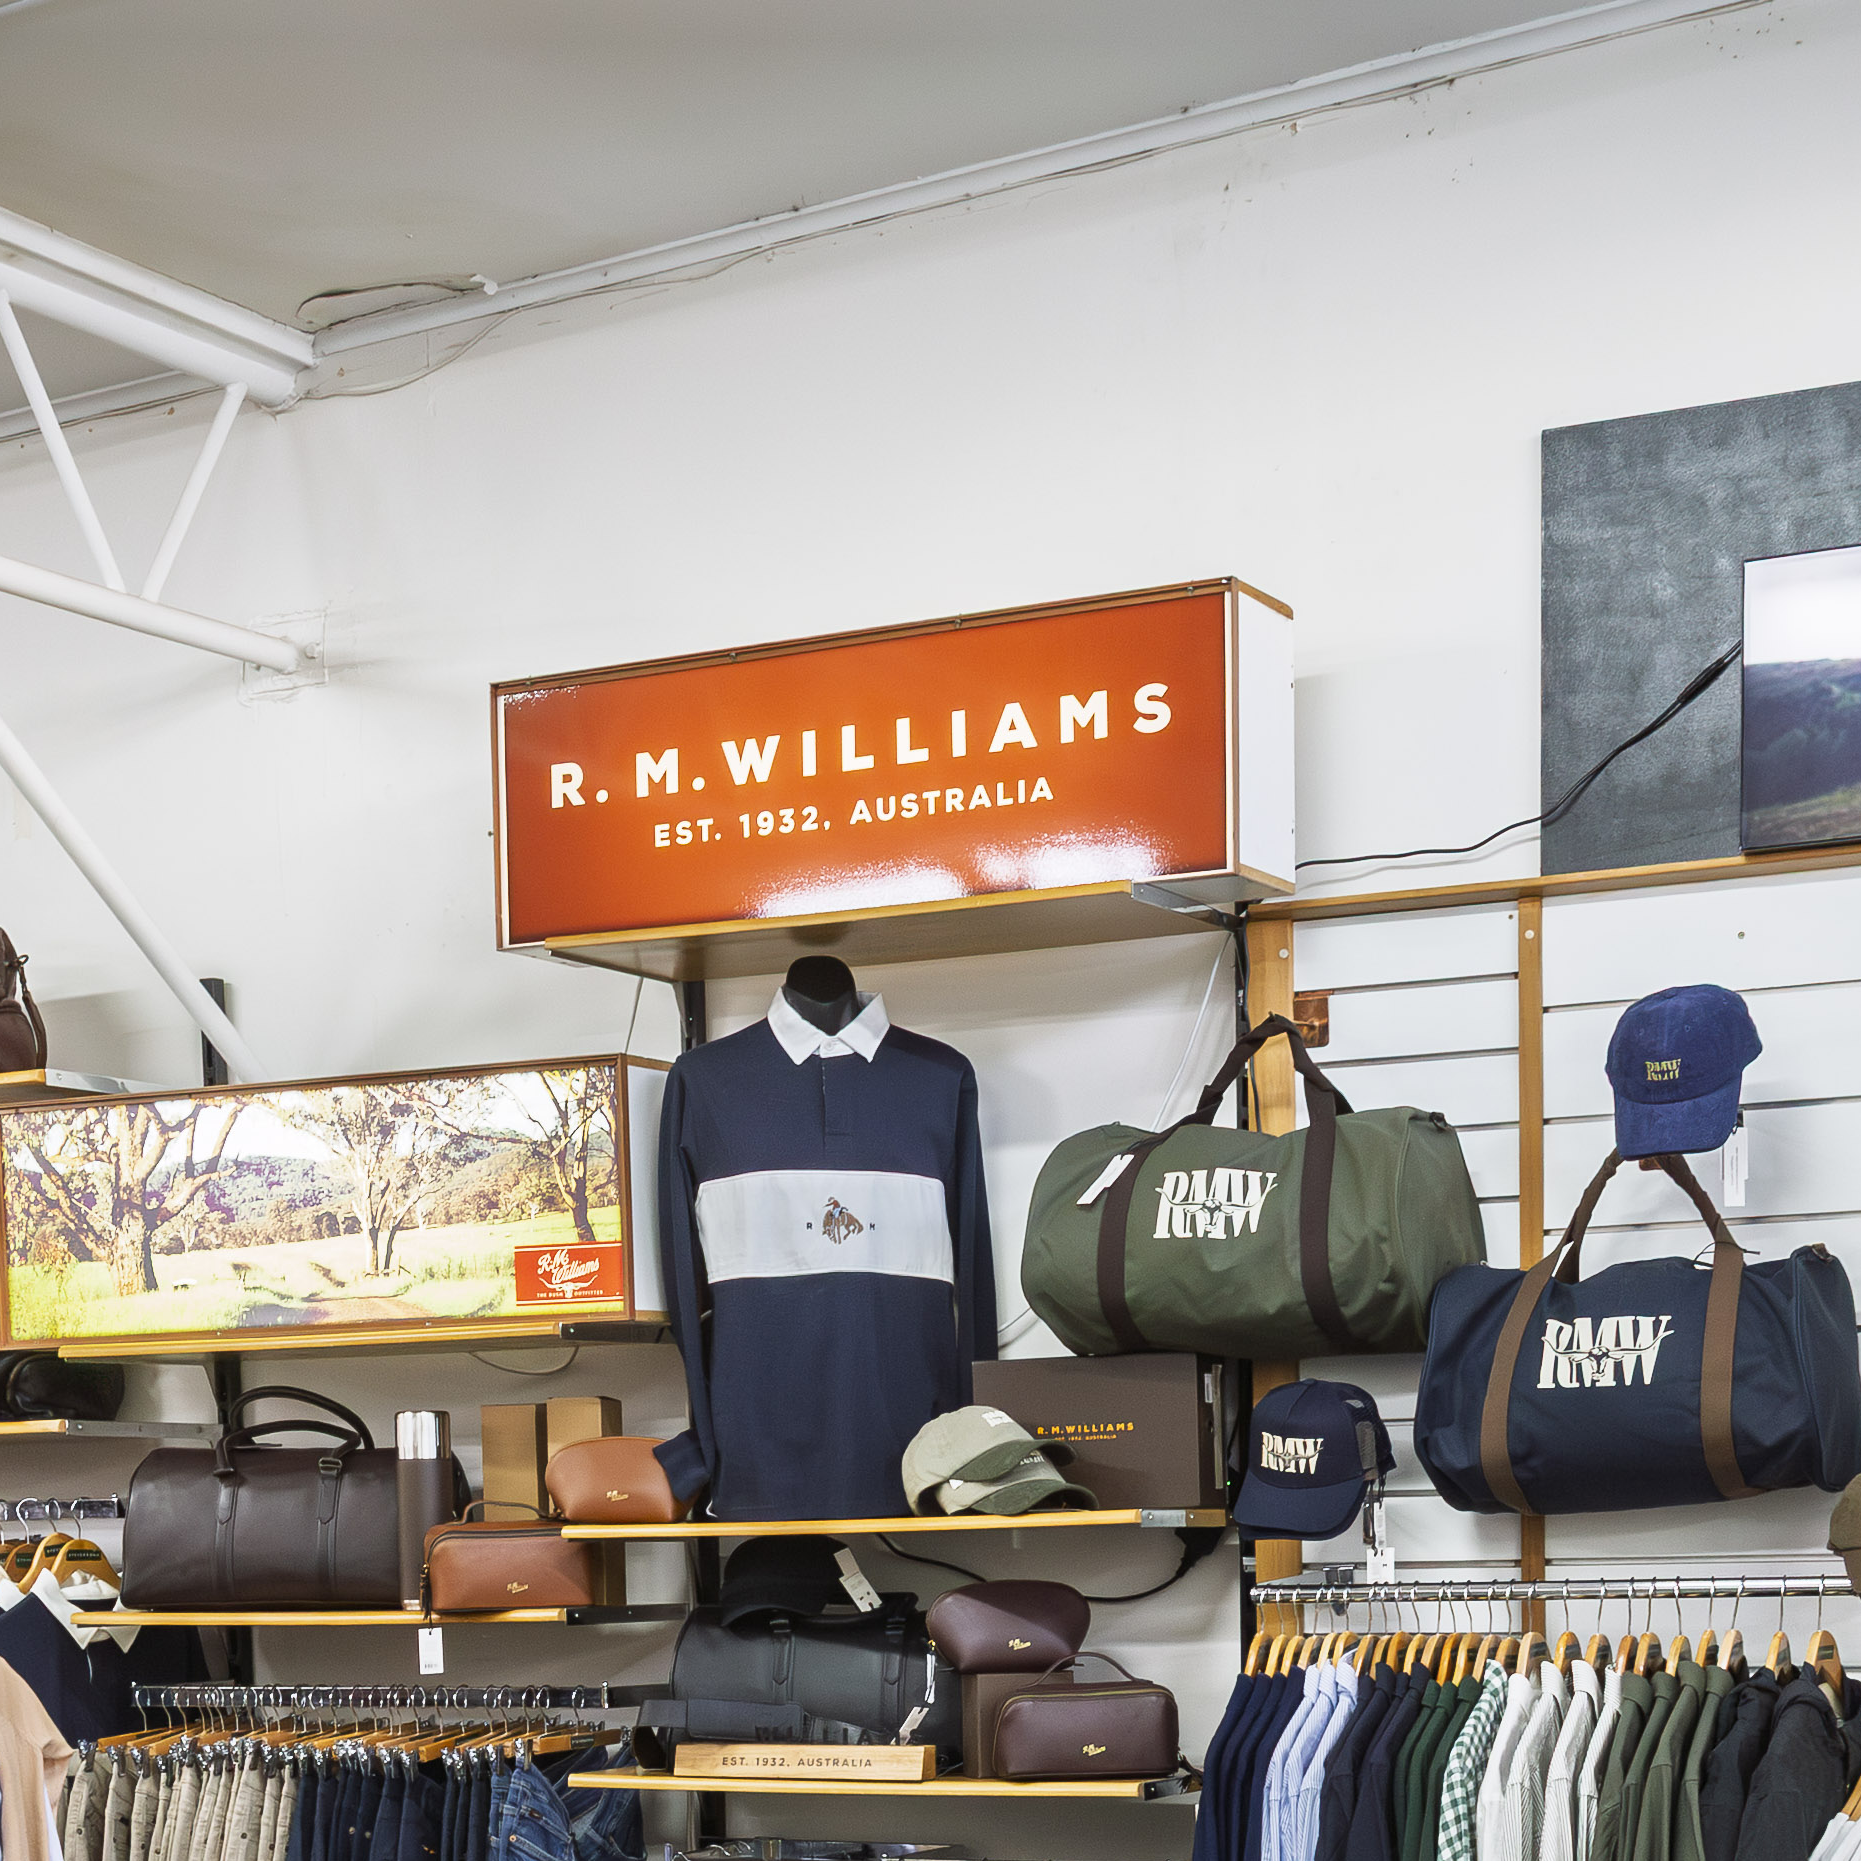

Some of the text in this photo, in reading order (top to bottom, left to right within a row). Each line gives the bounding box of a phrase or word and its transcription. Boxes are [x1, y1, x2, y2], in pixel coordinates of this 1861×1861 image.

[654, 818, 722, 848] EST.
[850, 777, 1054, 825] AUSTRALIA
[1153, 1167, 1278, 1239] RMW
[551, 1257, 600, 1284] Williams
[1537, 1316, 1674, 1389] RMW
[1261, 1432, 1324, 1474] RMW
[722, 1756, 749, 1766] EST.
[797, 1757, 872, 1767] AUSTRALIA
